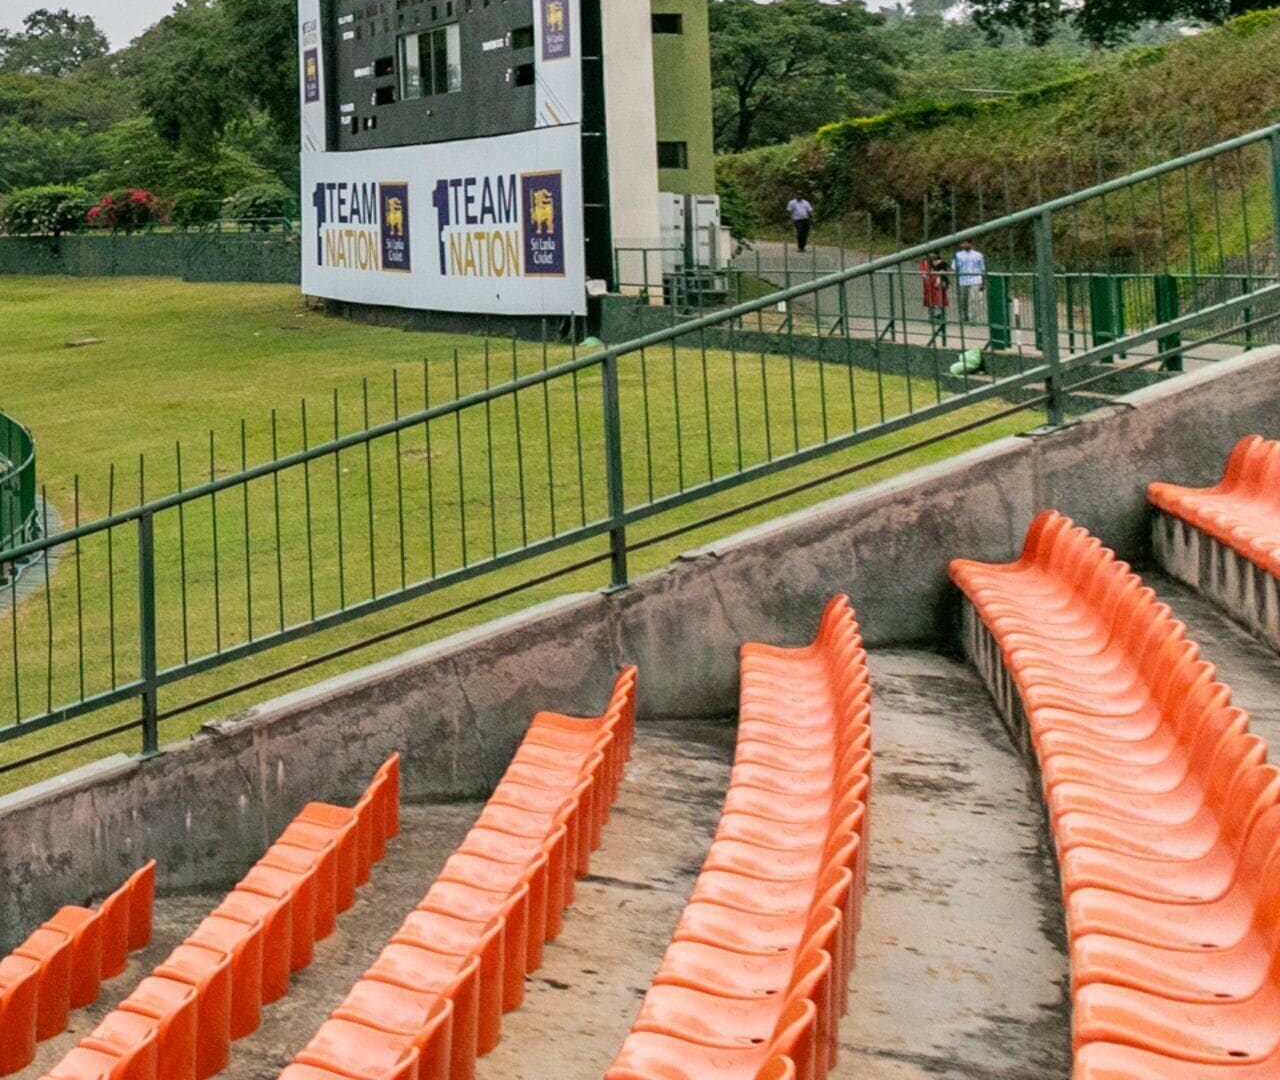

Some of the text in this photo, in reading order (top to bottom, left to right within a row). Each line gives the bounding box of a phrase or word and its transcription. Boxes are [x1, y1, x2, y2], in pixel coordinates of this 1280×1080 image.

[326, 182, 378, 225] TEAM
[449, 174, 518, 225] TEAM
[326, 229, 379, 270] NATION
[450, 231, 520, 278] NATION
